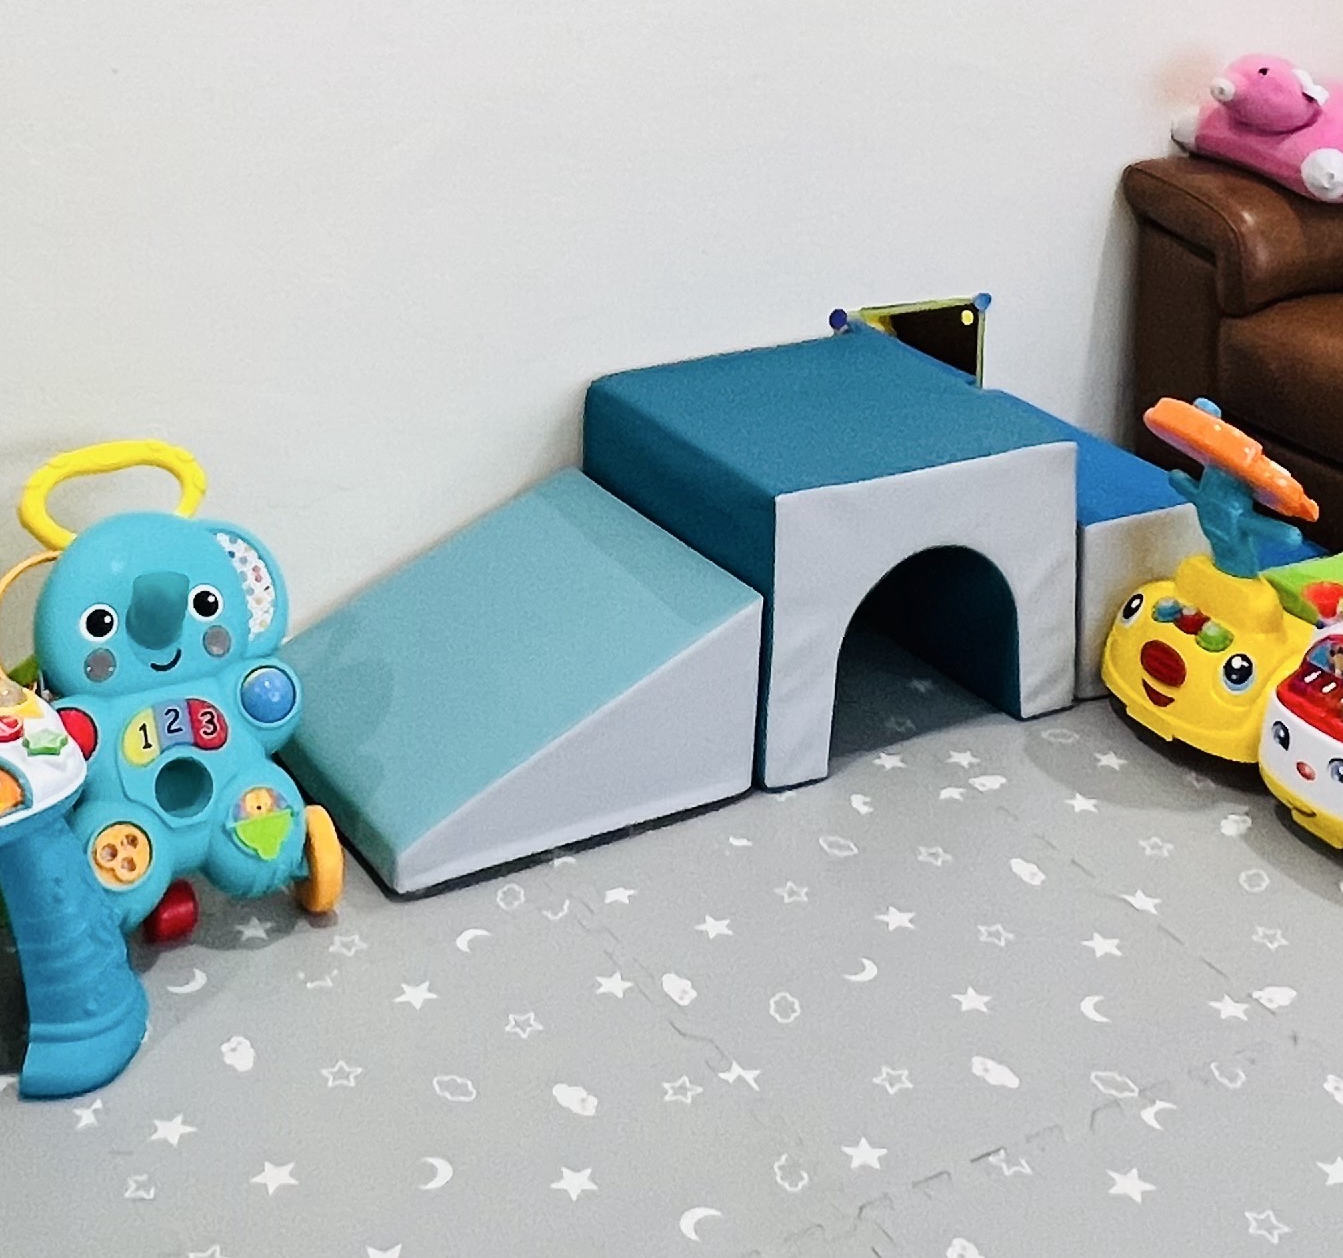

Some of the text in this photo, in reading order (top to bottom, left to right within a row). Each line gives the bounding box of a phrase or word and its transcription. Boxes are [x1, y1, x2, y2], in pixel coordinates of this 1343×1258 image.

[139, 708, 219, 750] 1 2 3
